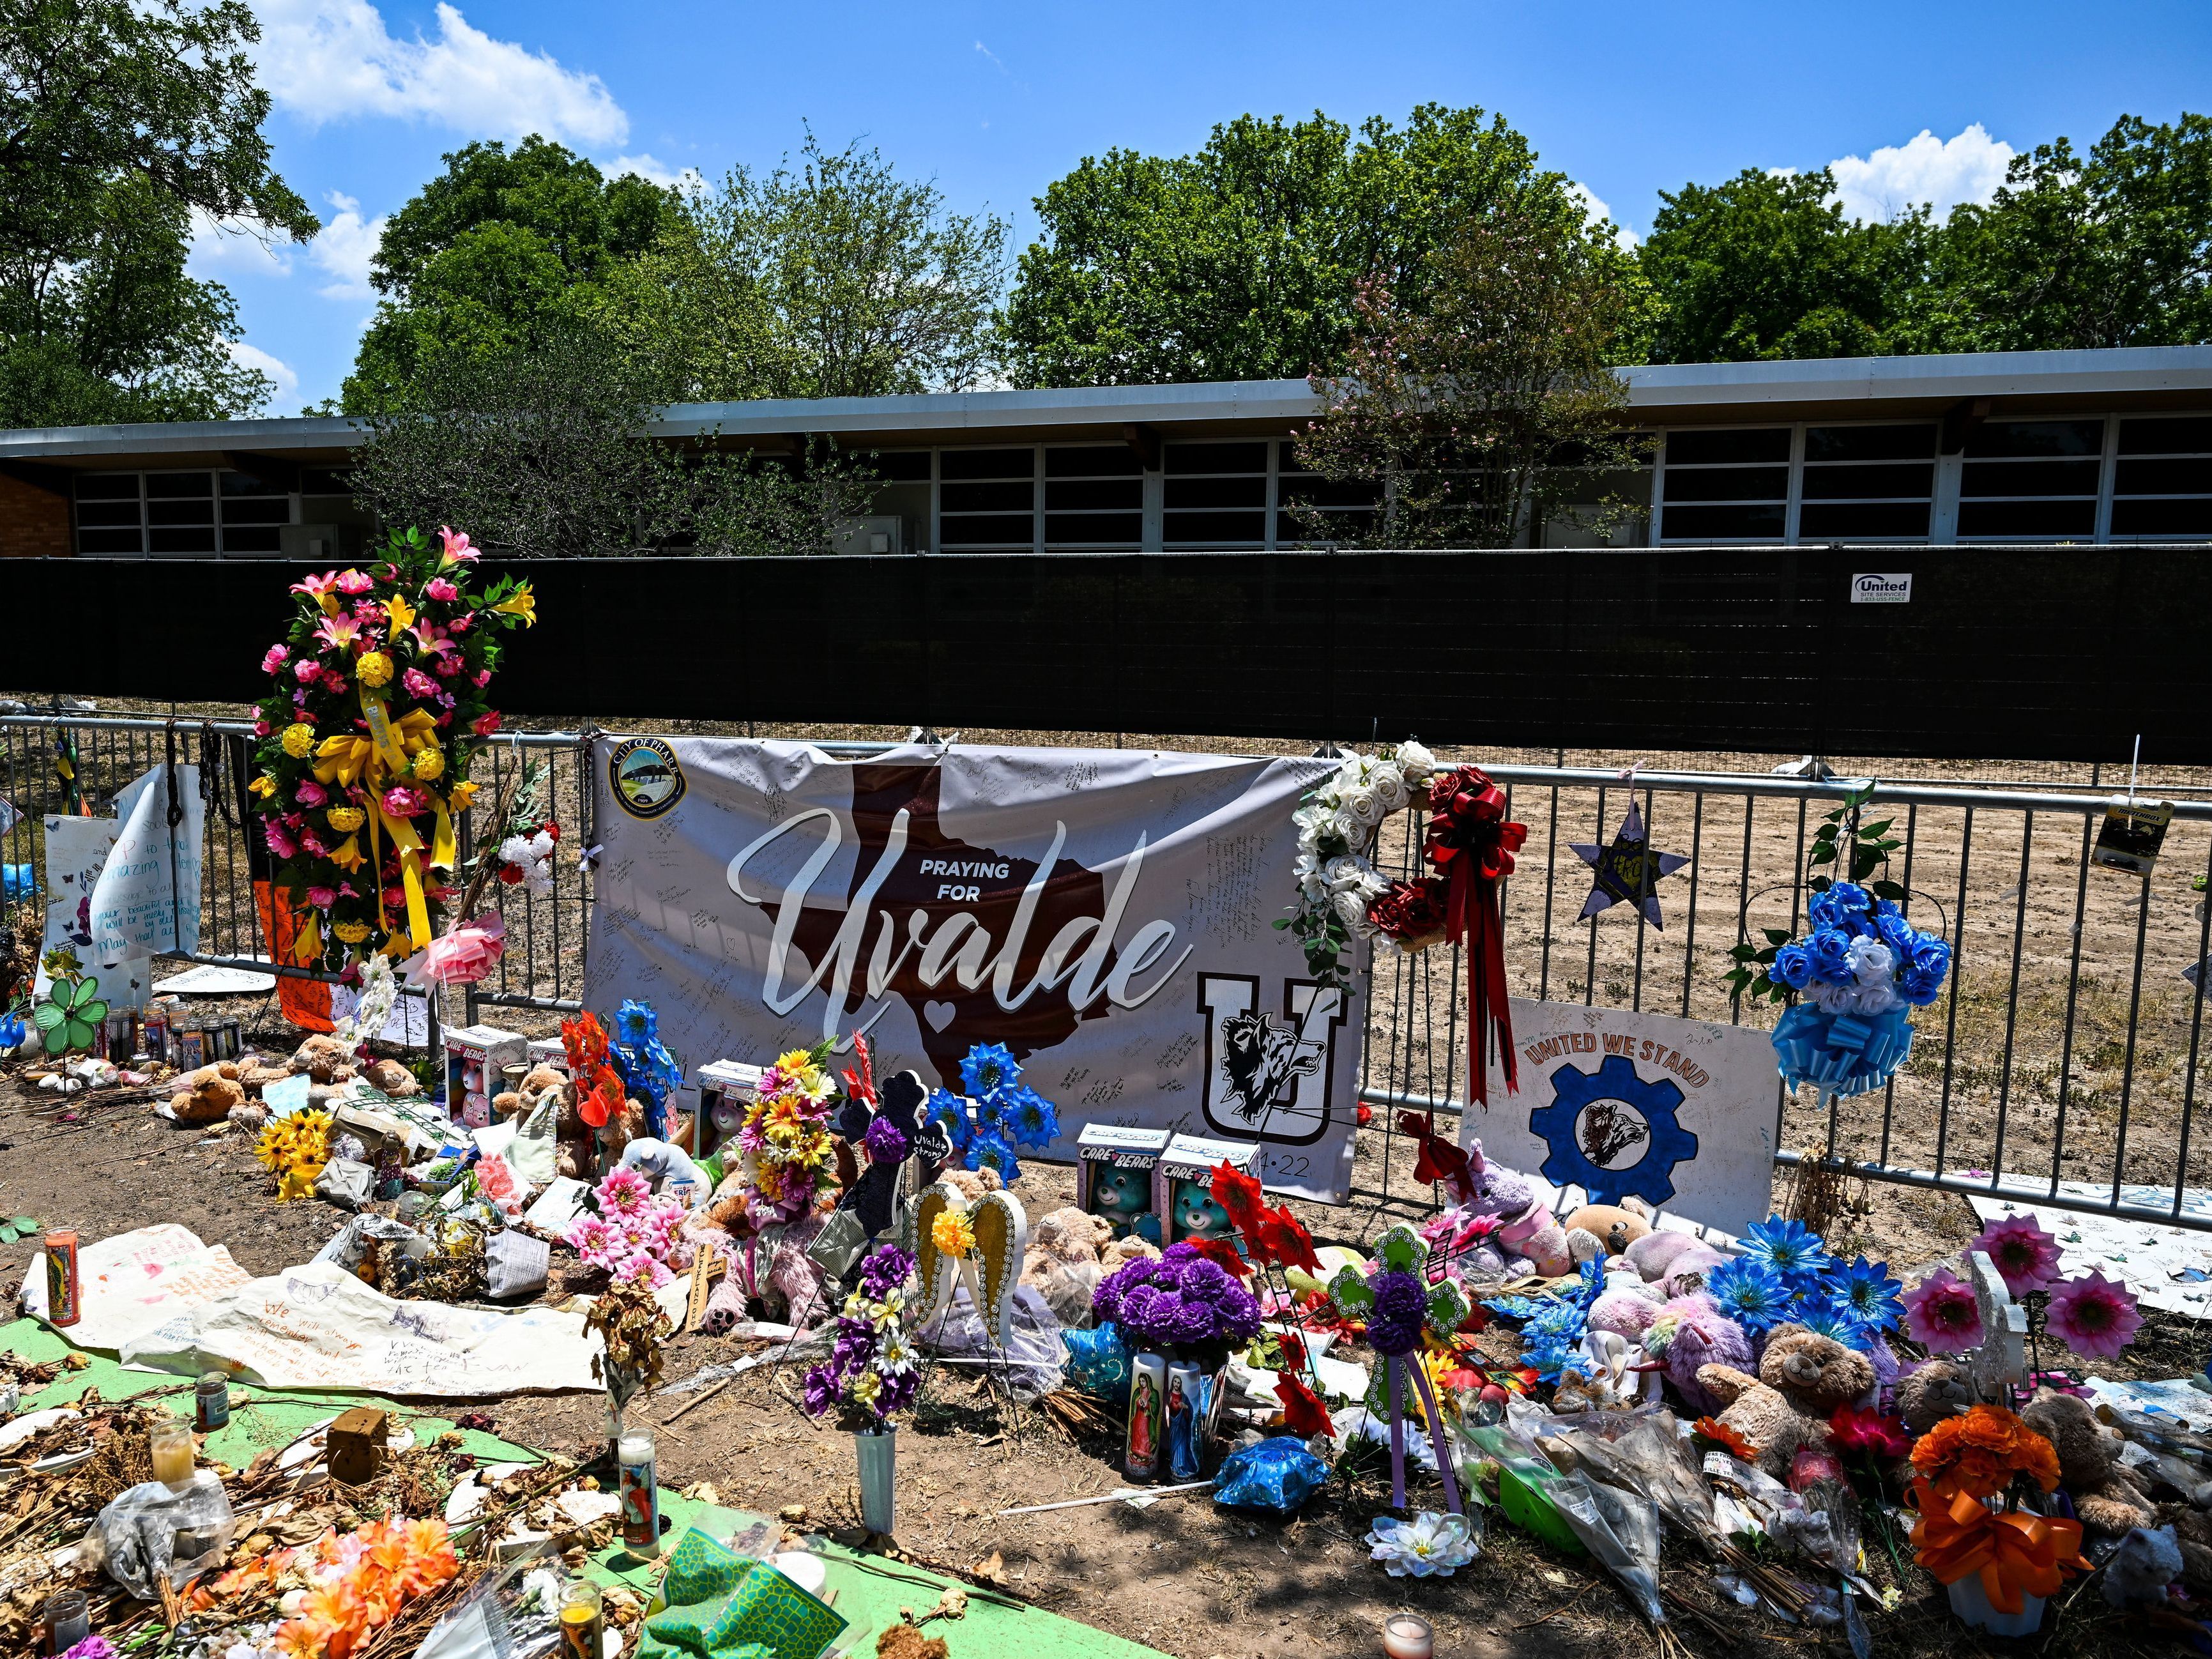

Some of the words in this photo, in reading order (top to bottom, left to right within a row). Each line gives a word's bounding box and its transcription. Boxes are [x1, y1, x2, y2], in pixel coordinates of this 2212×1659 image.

[1861, 580, 1907, 592] United
[613, 741, 632, 764] CITY
[634, 738, 650, 747] OF
[650, 740, 678, 774] PHARR
[743, 764, 755, 777] God
[919, 859, 1009, 880] PRAYING
[936, 885, 980, 902] FOR
[727, 807, 1194, 1055] Uvalde
[98, 938, 128, 956] May
[445, 1038, 464, 1051] CARE
[462, 1048, 487, 1062] BEARS
[528, 1048, 549, 1060] CARE
[1524, 1032, 1597, 1066] UNITED
[1602, 1032, 1636, 1057] WE
[1639, 1039, 1710, 1089] STAND
[698, 1074, 724, 1090] CARE
[913, 1147, 942, 1160] strong
[1079, 1146, 1115, 1161] CARE
[1114, 1154, 1158, 1168] BEARS
[1162, 1164, 1198, 1180] CARE
[264, 1298, 289, 1319] We
[247, 1323, 268, 1337] will
[259, 1316, 314, 1346] remember
[316, 1347, 342, 1360] and
